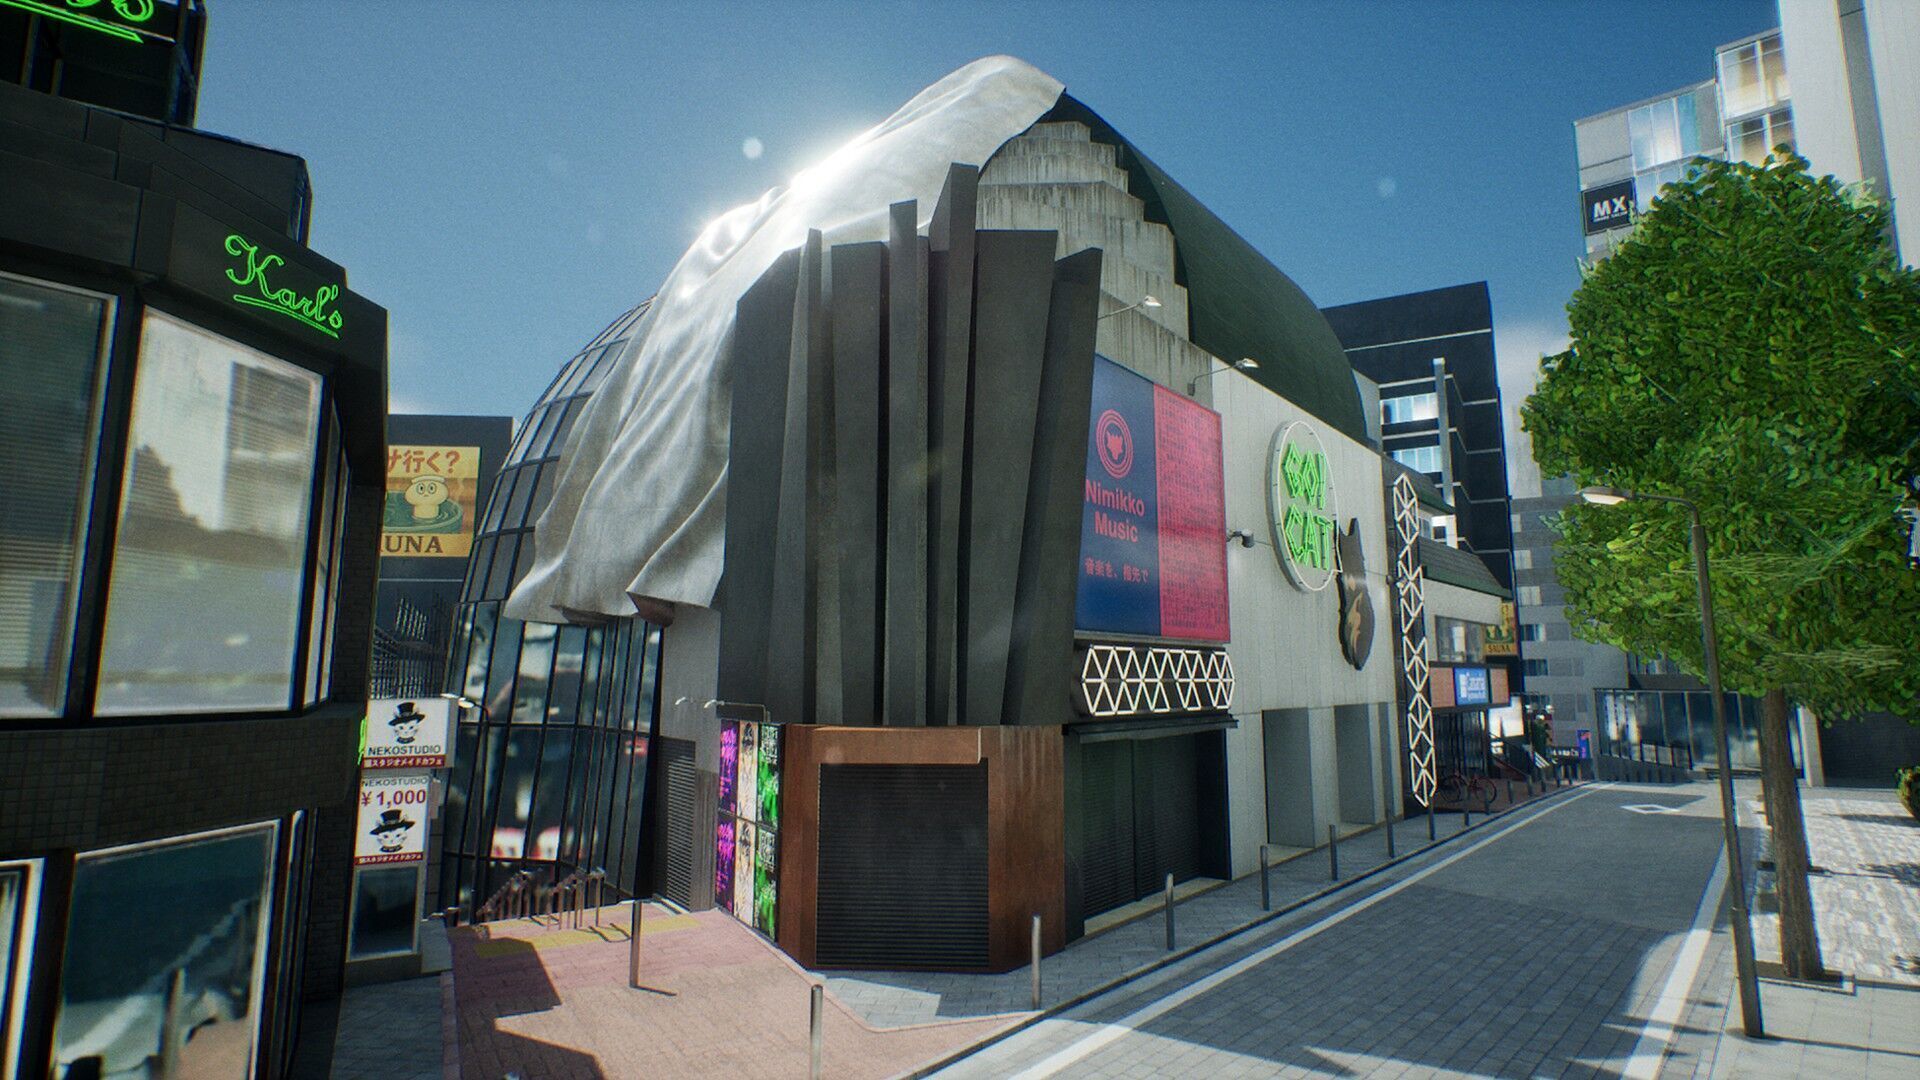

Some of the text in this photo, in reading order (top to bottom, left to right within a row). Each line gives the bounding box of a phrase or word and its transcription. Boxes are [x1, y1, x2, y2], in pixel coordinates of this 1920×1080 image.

[1593, 195, 1627, 218] MX
[225, 235, 343, 329] Karl's
[1085, 479, 1145, 517] Nimikko
[1094, 511, 1138, 542] Music
[1285, 504, 1333, 569] CAT
[382, 536, 443, 553] UNA
[368, 745, 440, 756] NEKOSTUDIO
[364, 757, 443, 768] スタジオメイドカフェ
[361, 777, 428, 787] NEKOSTUDIO
